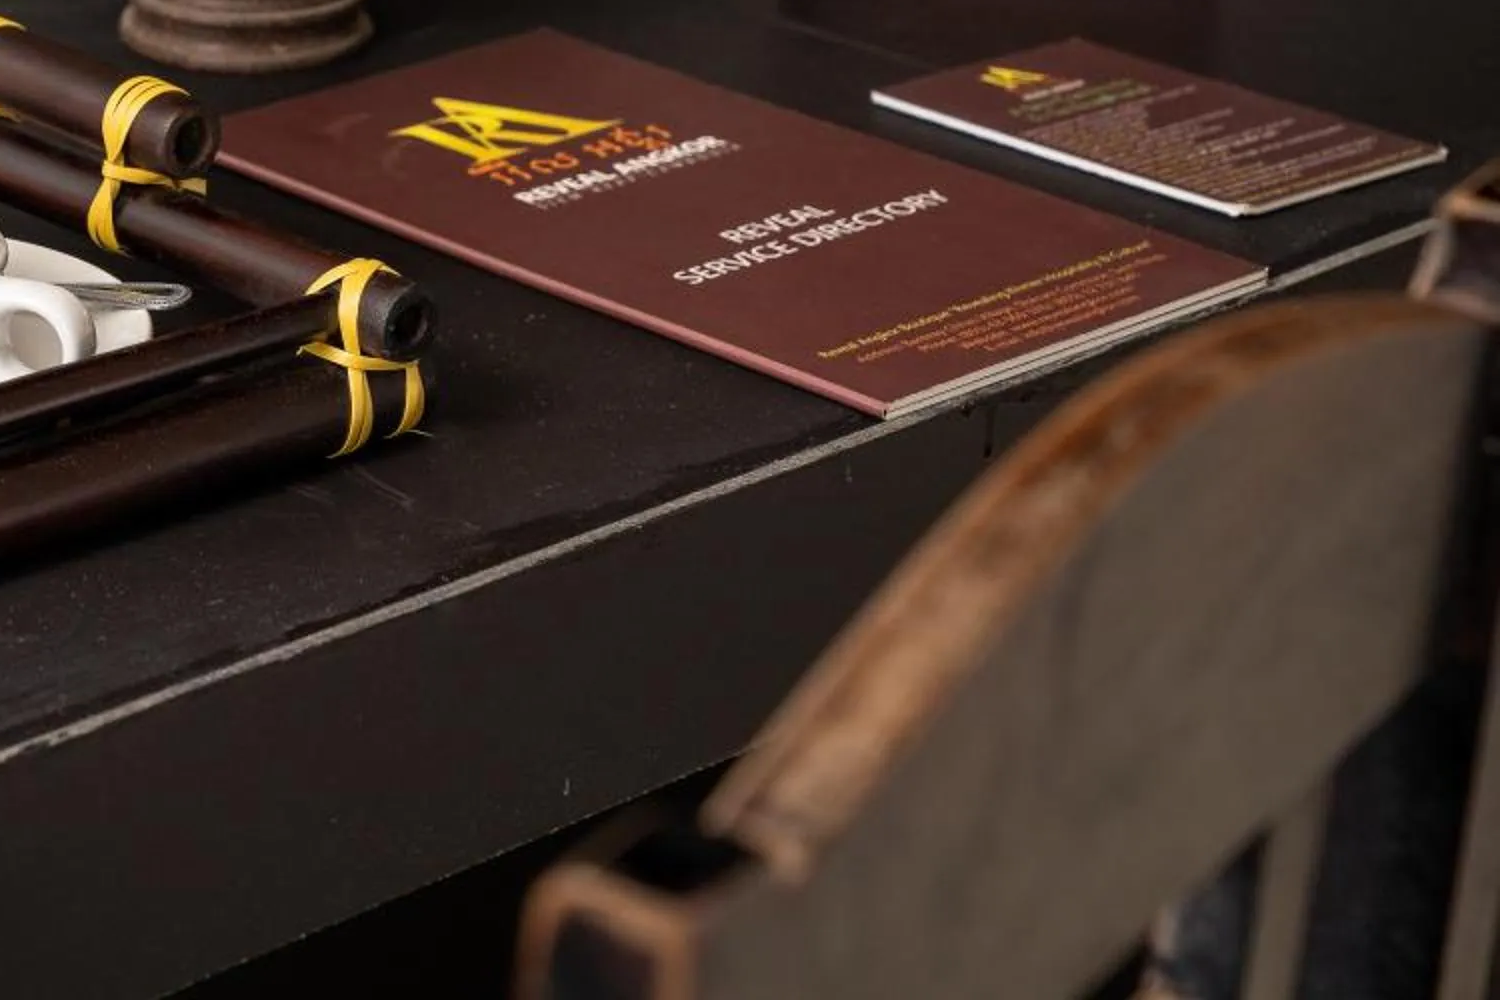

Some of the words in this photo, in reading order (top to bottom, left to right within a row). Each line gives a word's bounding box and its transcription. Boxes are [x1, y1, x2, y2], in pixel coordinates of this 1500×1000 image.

[515, 167, 617, 204] REVEAL
[611, 135, 728, 178] ANGKOR
[673, 236, 795, 286] SERVICE
[794, 188, 949, 255] DIRECTORY
[719, 202, 836, 246] REVEAL
